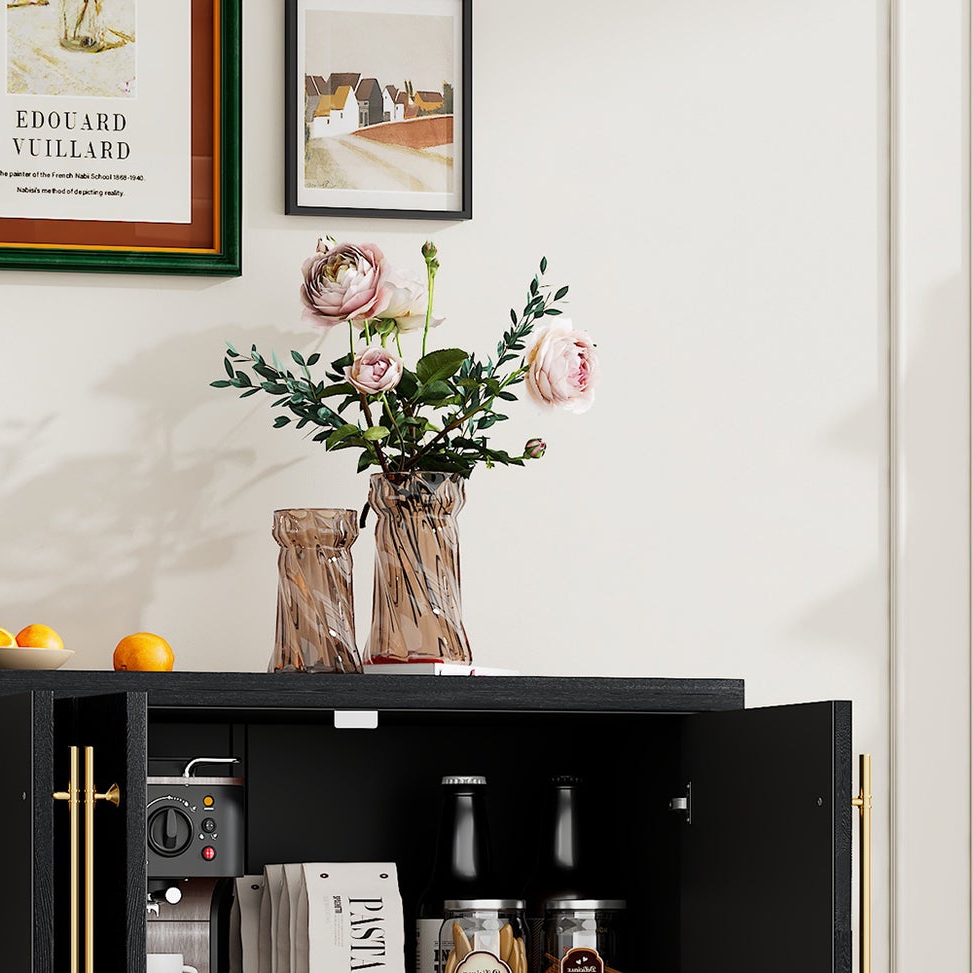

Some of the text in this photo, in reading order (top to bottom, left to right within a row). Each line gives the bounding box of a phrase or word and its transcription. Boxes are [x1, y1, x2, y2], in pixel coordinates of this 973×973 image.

[16, 110, 127, 132] EDOUARD
[12, 137, 131, 160] VUILLARD
[74, 189, 104, 197] depicting
[348, 896, 387, 971] PASTA
